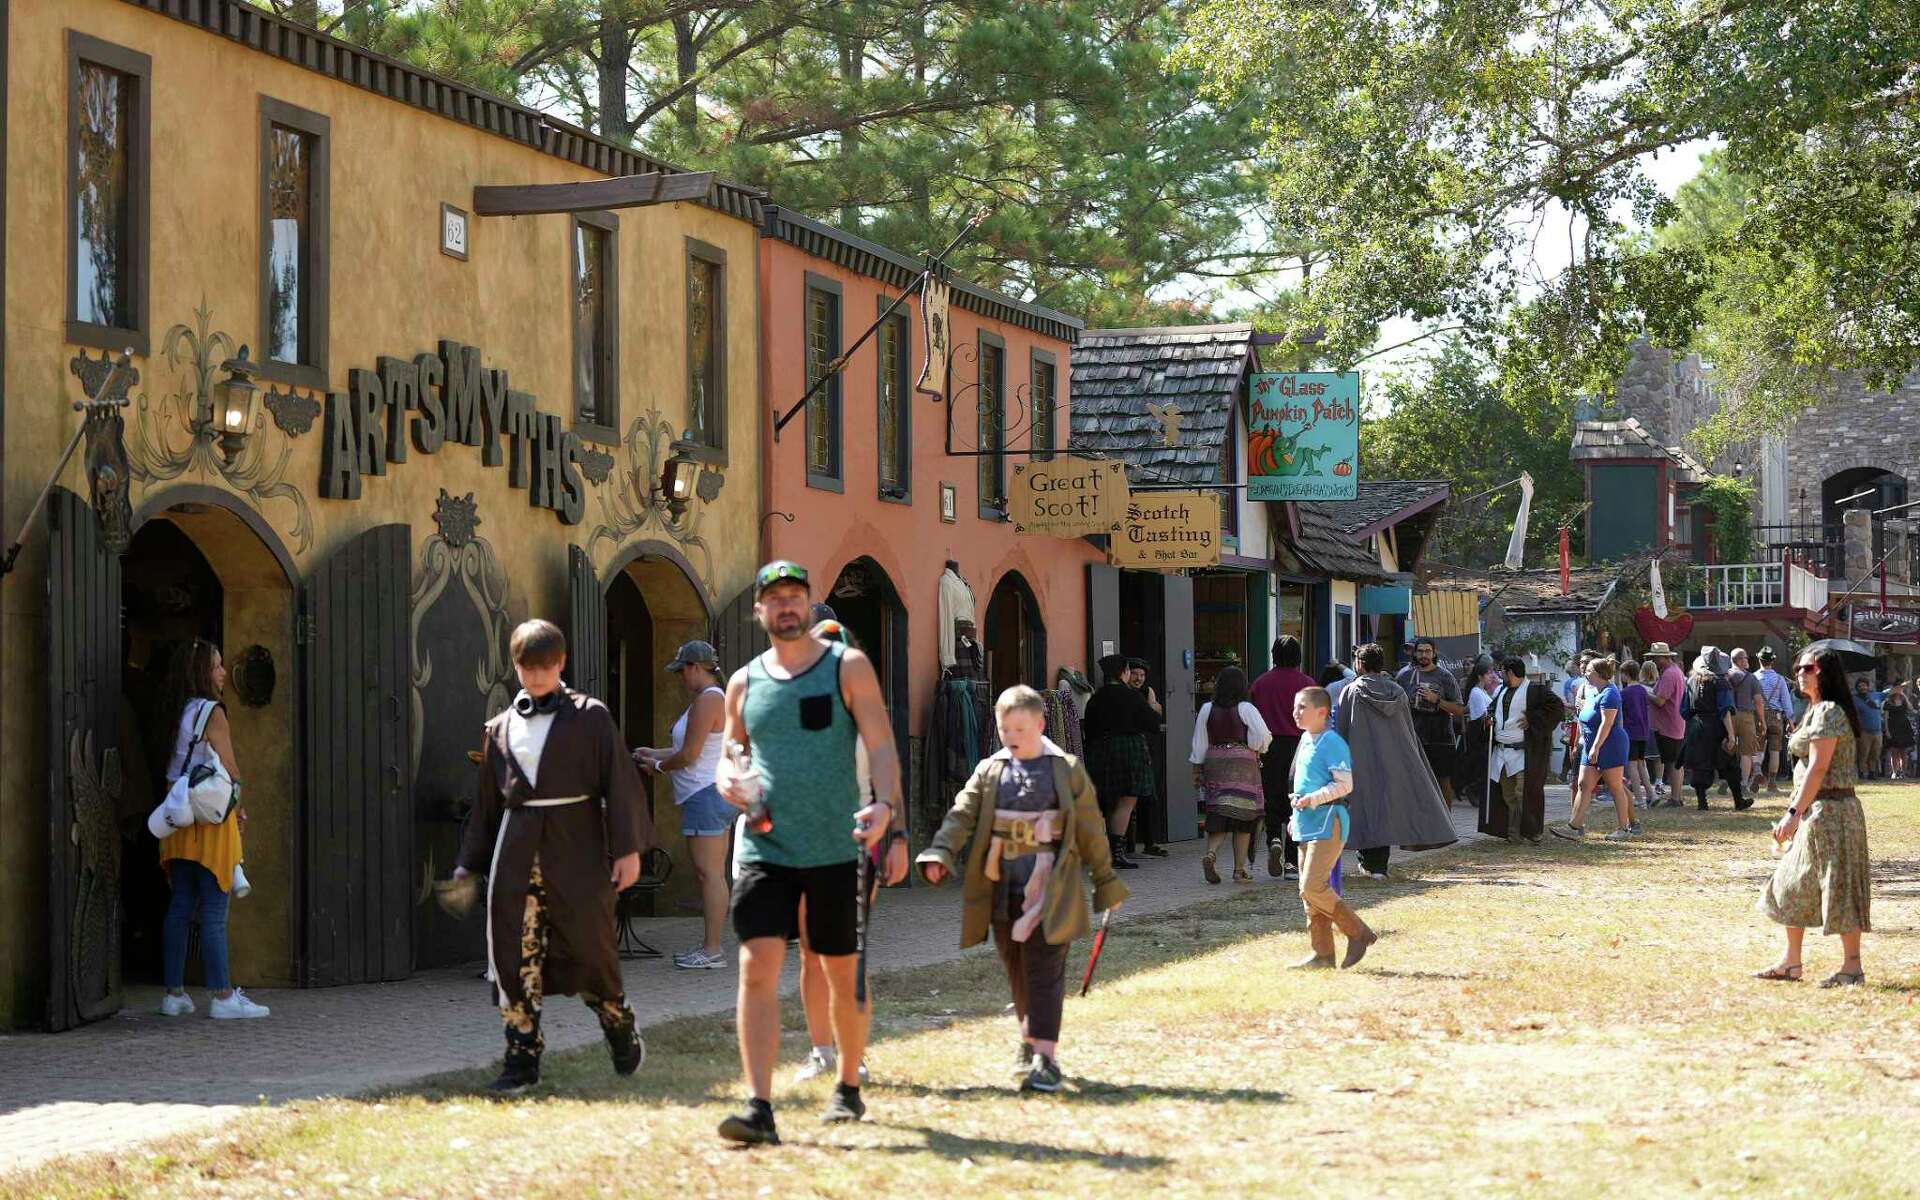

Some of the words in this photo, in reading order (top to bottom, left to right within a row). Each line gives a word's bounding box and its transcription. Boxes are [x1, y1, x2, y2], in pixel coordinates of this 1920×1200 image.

[447, 219, 461, 245] 62
[1251, 398, 1307, 428] Pumpkin
[1312, 397, 1355, 427] Patch
[319, 340, 585, 525] ARTSMYTHS
[1029, 469, 1103, 493] Great
[1034, 494, 1098, 518] Scot!
[1126, 502, 1191, 524] Scotch
[1128, 525, 1212, 548] Tasting
[1138, 550, 1147, 559] &
[1180, 549, 1199, 559] Bar
